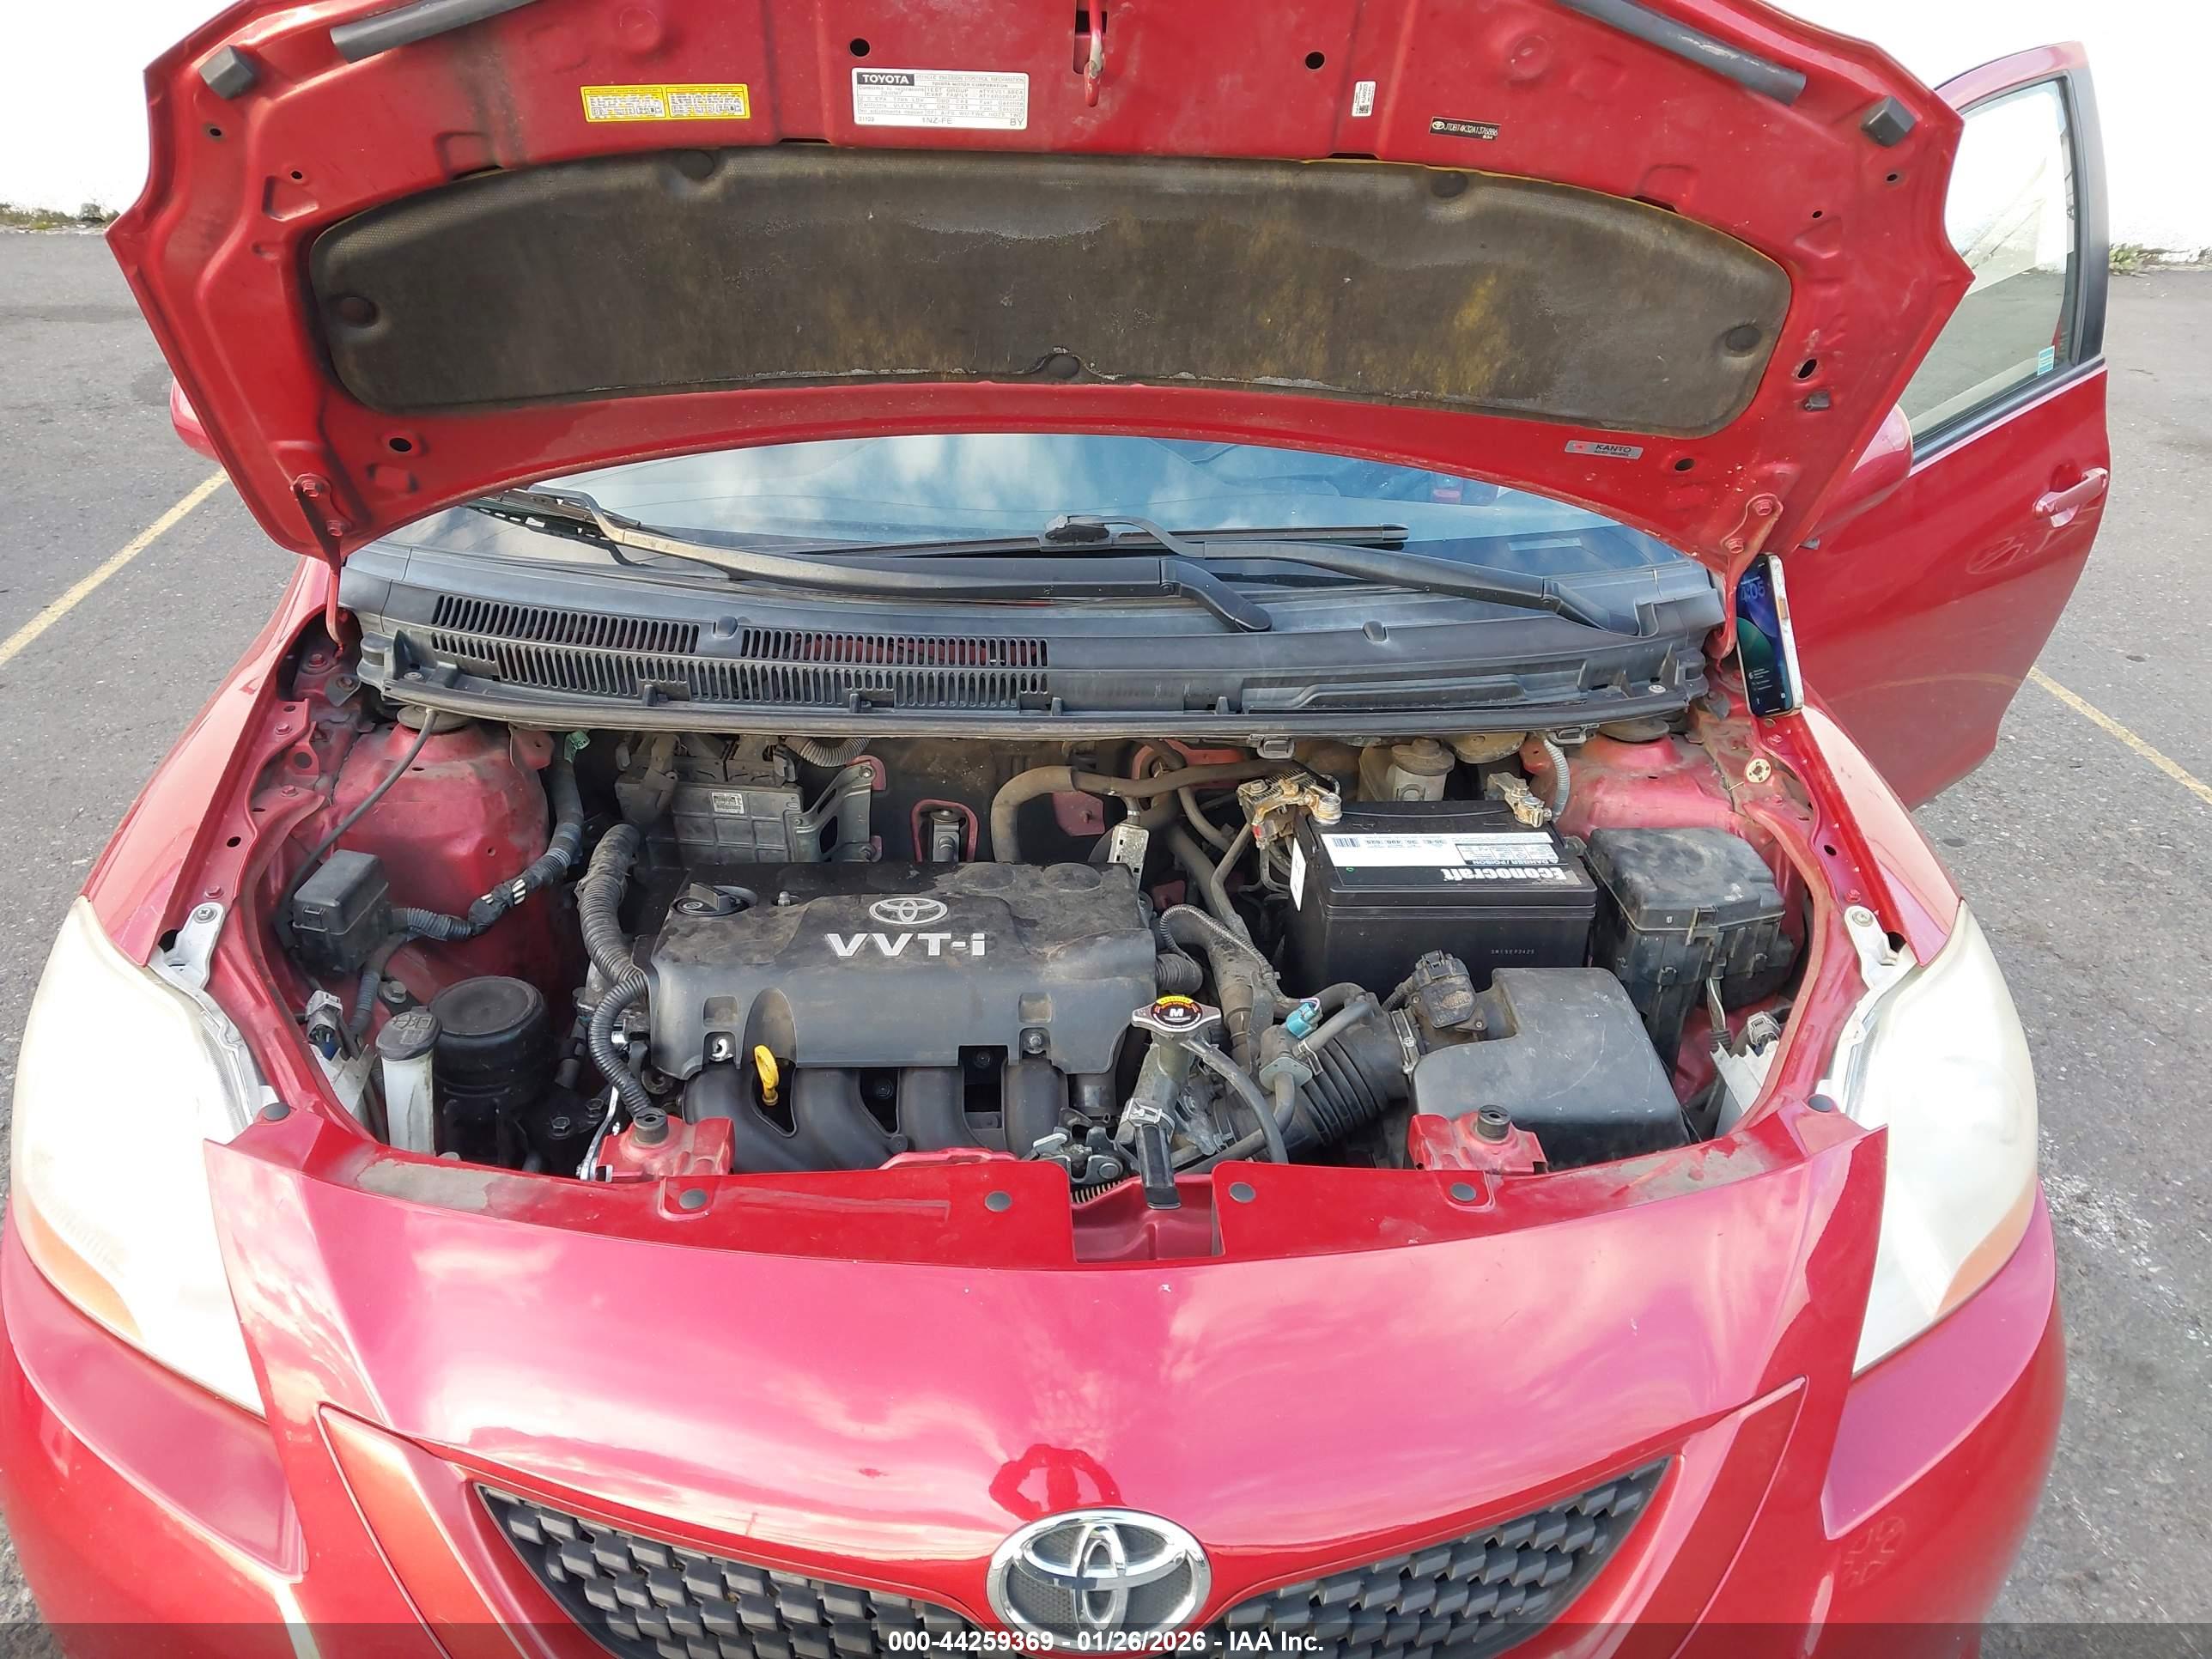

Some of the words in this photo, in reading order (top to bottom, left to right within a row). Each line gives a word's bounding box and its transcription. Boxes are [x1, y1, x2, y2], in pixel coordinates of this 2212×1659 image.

[862, 74, 909, 84] TOYOTA
[1010, 118, 1024, 126] BY
[1595, 444, 1631, 453] KANTO
[1441, 867, 1567, 882] Econocraft
[826, 933, 986, 957] VVT-i
